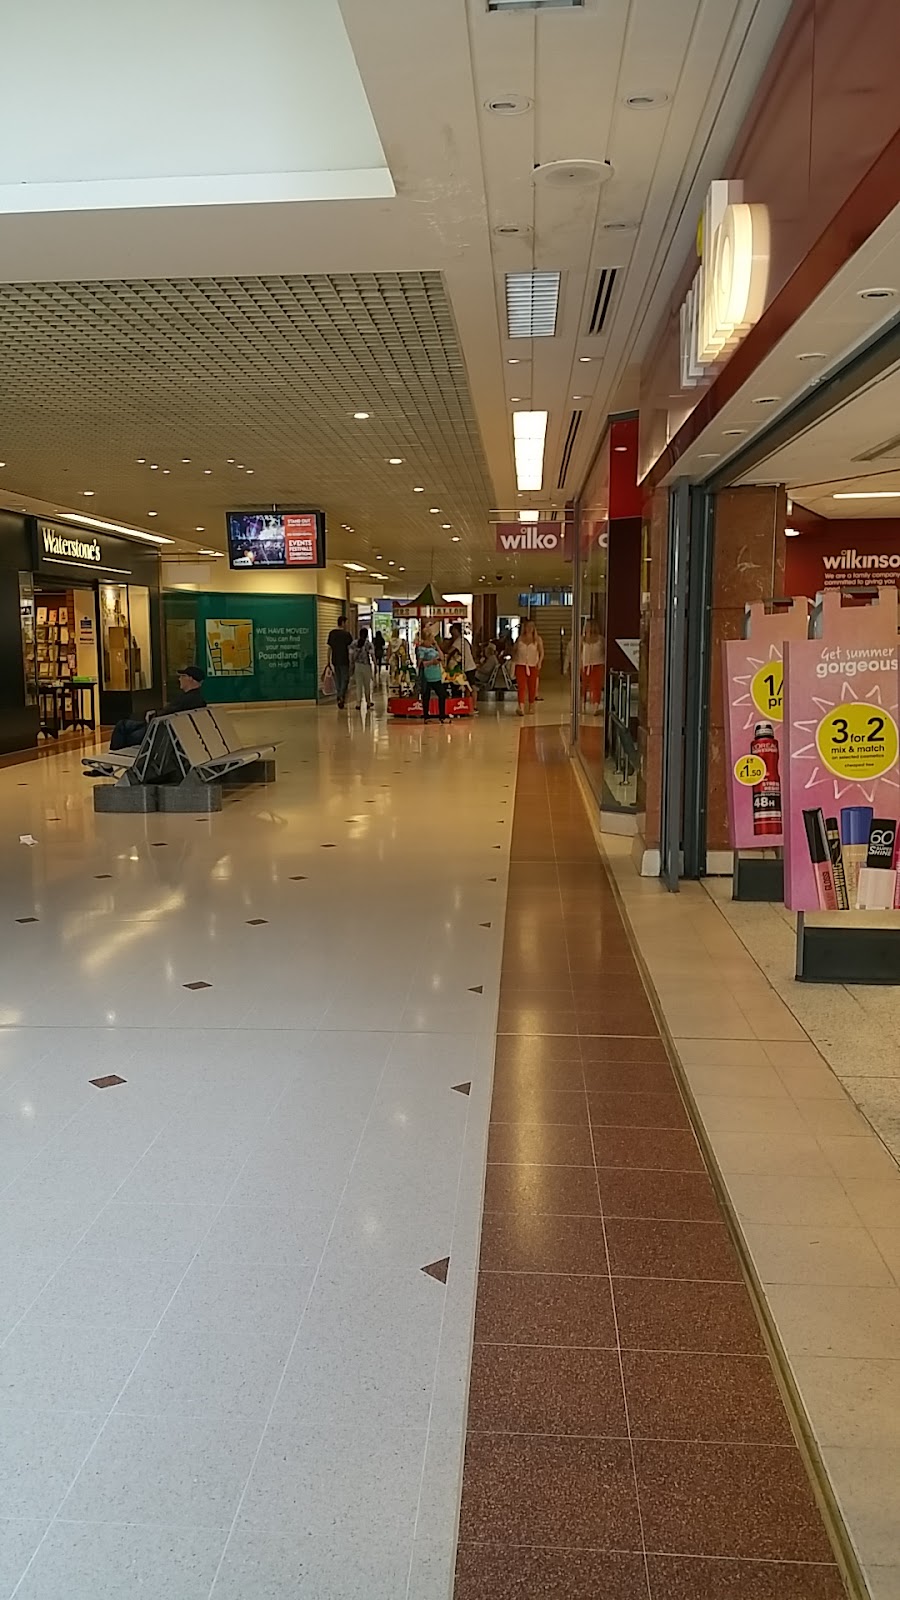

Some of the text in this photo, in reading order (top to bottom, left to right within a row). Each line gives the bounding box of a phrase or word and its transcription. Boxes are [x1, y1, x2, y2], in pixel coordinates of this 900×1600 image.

[42, 527, 101, 561] Waterstone's
[500, 527, 558, 549] wilko
[853, 572, 871, 580] family
[872, 572, 900, 580] company
[259, 651, 298, 660] Poundland
[821, 646, 895, 662] Get summer
[278, 661, 291, 669] High
[816, 659, 898, 678] gorgeous
[831, 719, 849, 744] 3
[850, 734, 866, 743] for
[740, 764, 762, 778] £1.50
[753, 797, 776, 808] 48H
[870, 830, 895, 845] 60
